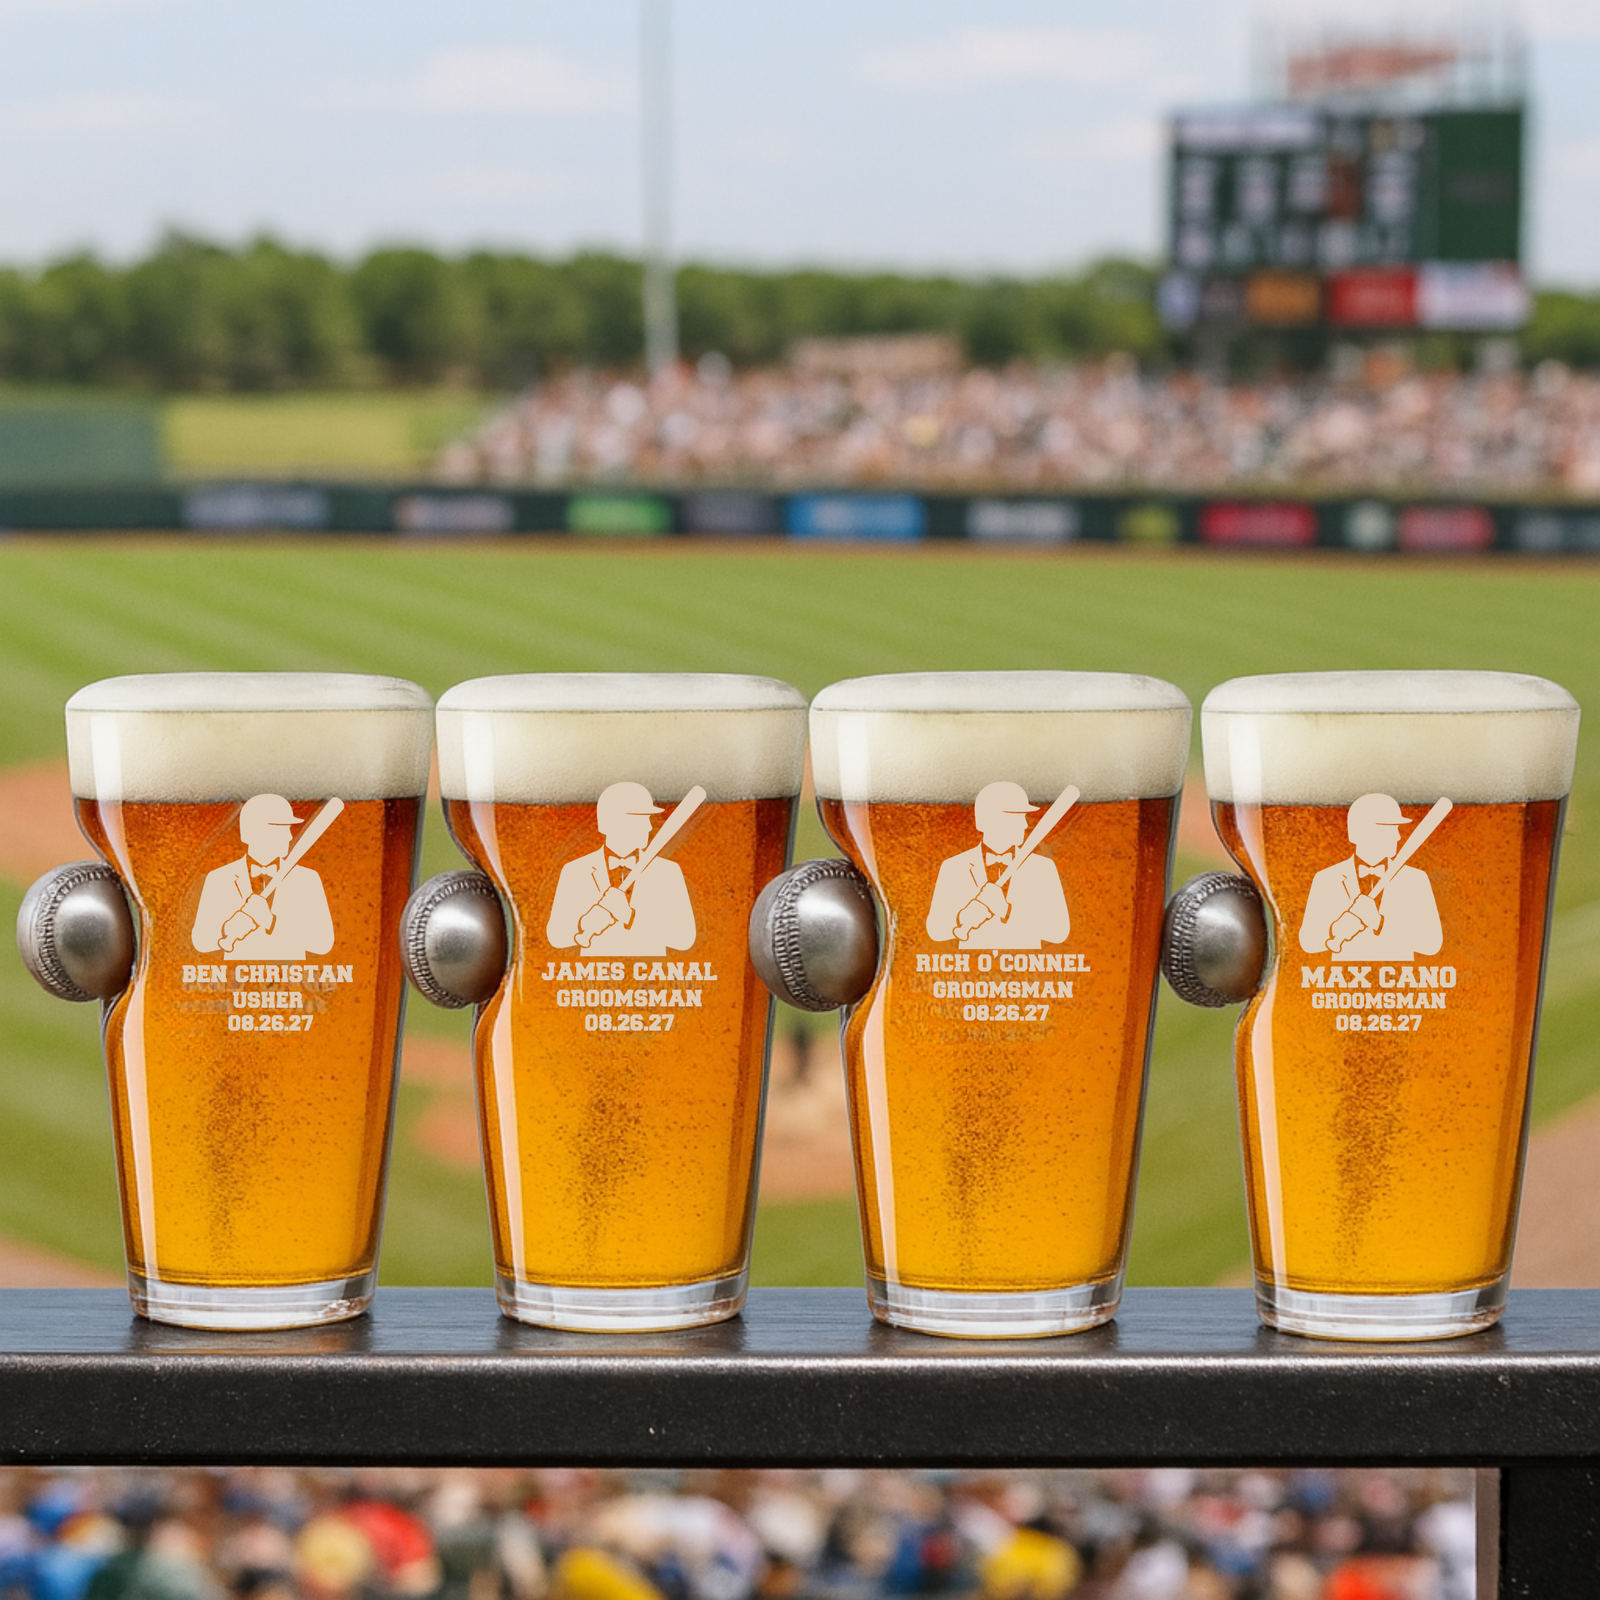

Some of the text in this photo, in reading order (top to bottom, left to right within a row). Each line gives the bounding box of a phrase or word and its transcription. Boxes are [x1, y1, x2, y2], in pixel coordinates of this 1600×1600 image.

[916, 950, 1091, 972] RICH O'CONNEL
[182, 965, 353, 983] BEN CHRISTAN
[541, 962, 718, 981] JAMES CANAL
[1301, 966, 1457, 988] MAX CANO
[556, 989, 702, 1007] GROOMSMAN
[933, 981, 1073, 998] GROOMSMAN
[232, 991, 303, 1008] USHER
[1311, 992, 1446, 1009] GROOMSMAN
[963, 1004, 1050, 1021] 08.26.27
[228, 1014, 314, 1031] 08.26.27
[584, 1014, 675, 1031] 08.26.27
[1336, 1014, 1423, 1031] 08.26.27
